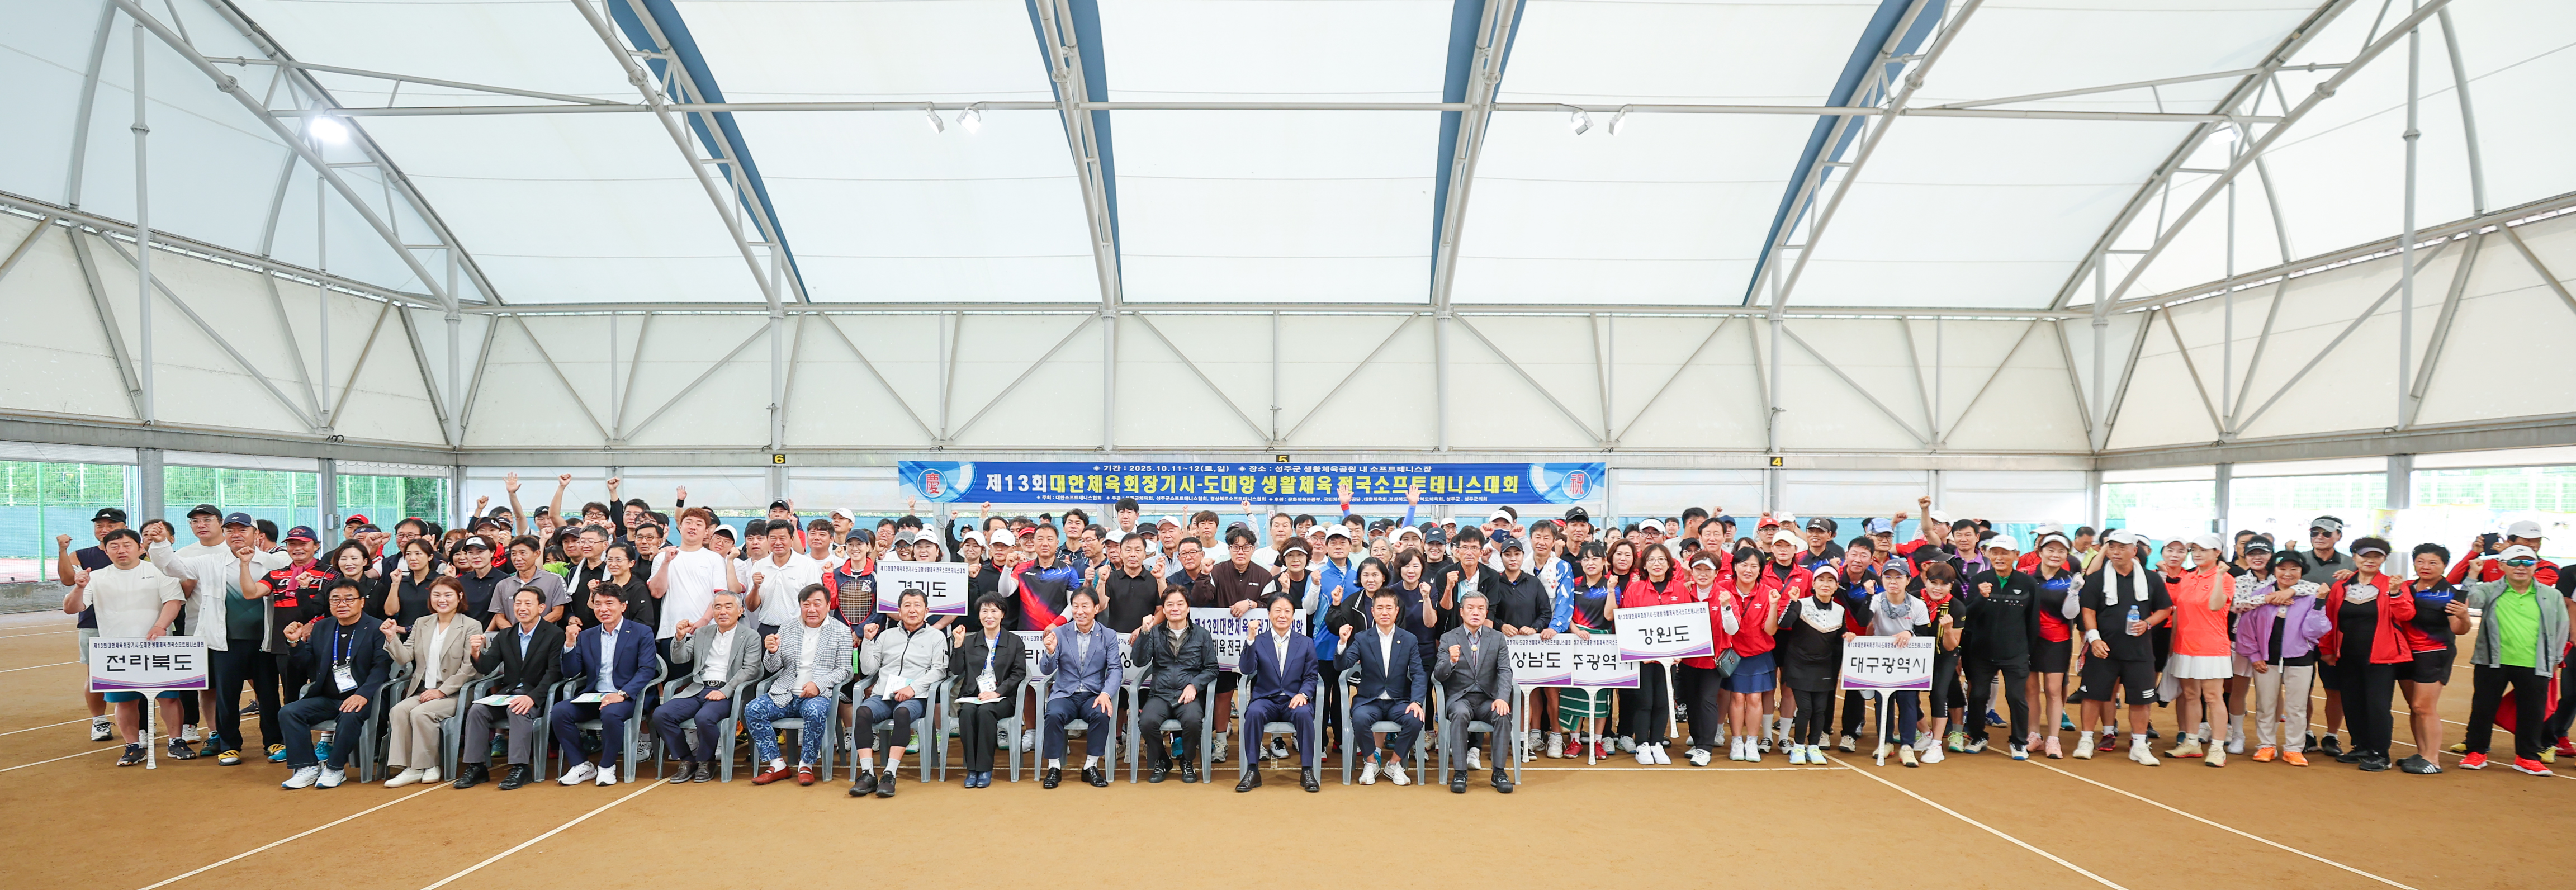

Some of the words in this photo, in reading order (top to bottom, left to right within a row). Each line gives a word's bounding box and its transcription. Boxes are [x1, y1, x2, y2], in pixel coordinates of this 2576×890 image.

[775, 455, 784, 463] 6
[1772, 457, 1782, 466] 4
[1261, 475, 1332, 494] 생활체육
[1337, 475, 1518, 494] 전국소프트테니스대회
[1570, 473, 1584, 495] 祝
[1638, 625, 1690, 645] 강원도
[107, 654, 192, 671] 전라북도
[1511, 652, 1561, 668] 상남도
[1574, 654, 1633, 670] 주광역
[1851, 657, 1926, 674] 대구광역시
